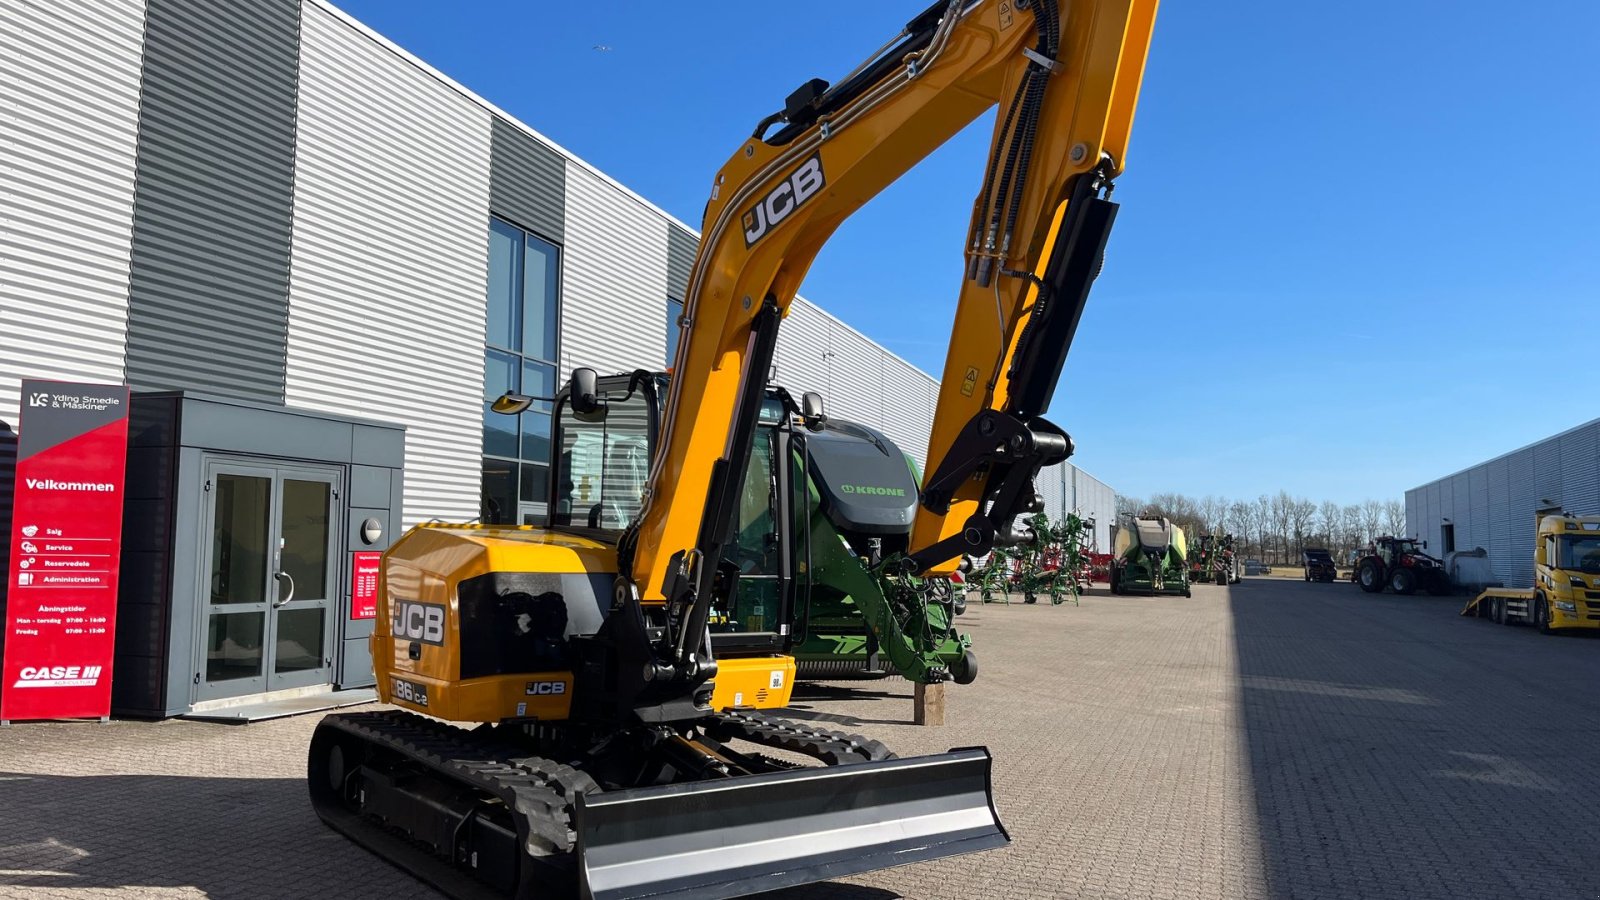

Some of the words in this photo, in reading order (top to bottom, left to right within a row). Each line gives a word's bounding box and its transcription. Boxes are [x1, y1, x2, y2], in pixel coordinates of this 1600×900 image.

[746, 158, 823, 244] JCB
[52, 394, 80, 404] Yding
[82, 396, 120, 405] Smedie
[62, 402, 107, 411] Maskiner
[26, 479, 114, 492] Velkommen
[856, 486, 905, 497] KRONE
[38, 605, 86, 613] Åbningstider
[393, 603, 444, 643] JCB
[20, 666, 81, 680] CASE
[396, 680, 413, 701] 86
[526, 682, 565, 695] JCB
